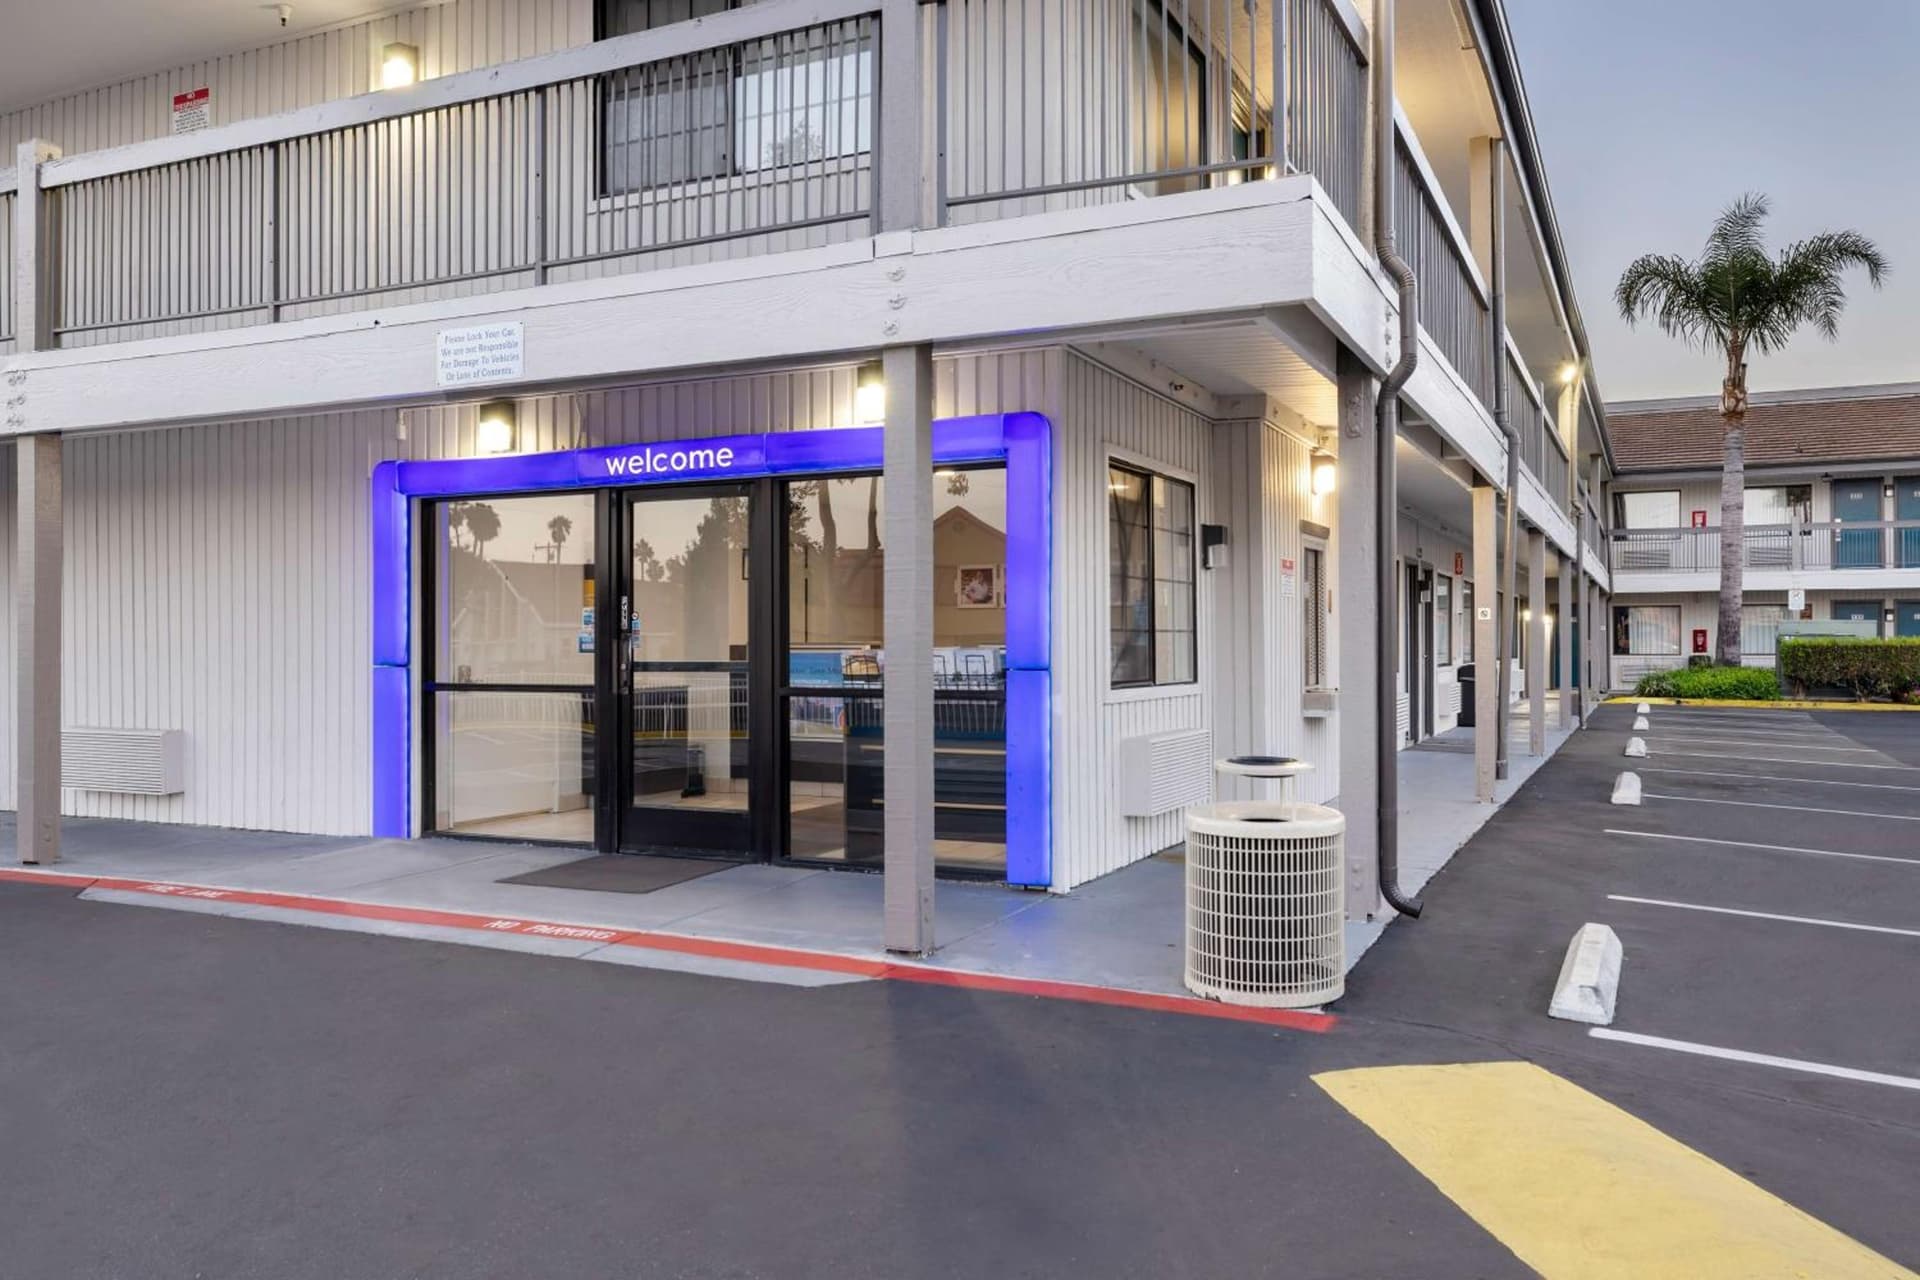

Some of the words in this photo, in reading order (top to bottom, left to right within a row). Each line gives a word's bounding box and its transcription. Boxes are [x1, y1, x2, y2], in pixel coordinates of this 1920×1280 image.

[445, 335, 465, 345] Please
[467, 332, 482, 341] Lock
[484, 330, 500, 338] Your
[441, 348, 452, 357] We
[453, 348, 464, 356] are
[465, 345, 477, 353] not
[478, 341, 519, 353] Responsible
[440, 360, 452, 369] For
[453, 358, 479, 369] Damage
[481, 356, 490, 364] To
[491, 354, 519, 364] Vehicles
[446, 372, 455, 381] Or
[456, 371, 471, 380] Loss
[473, 368, 481, 378] of
[606, 447, 734, 476] welcome
[482, 919, 521, 929] NO
[522, 924, 617, 939] PARKING
